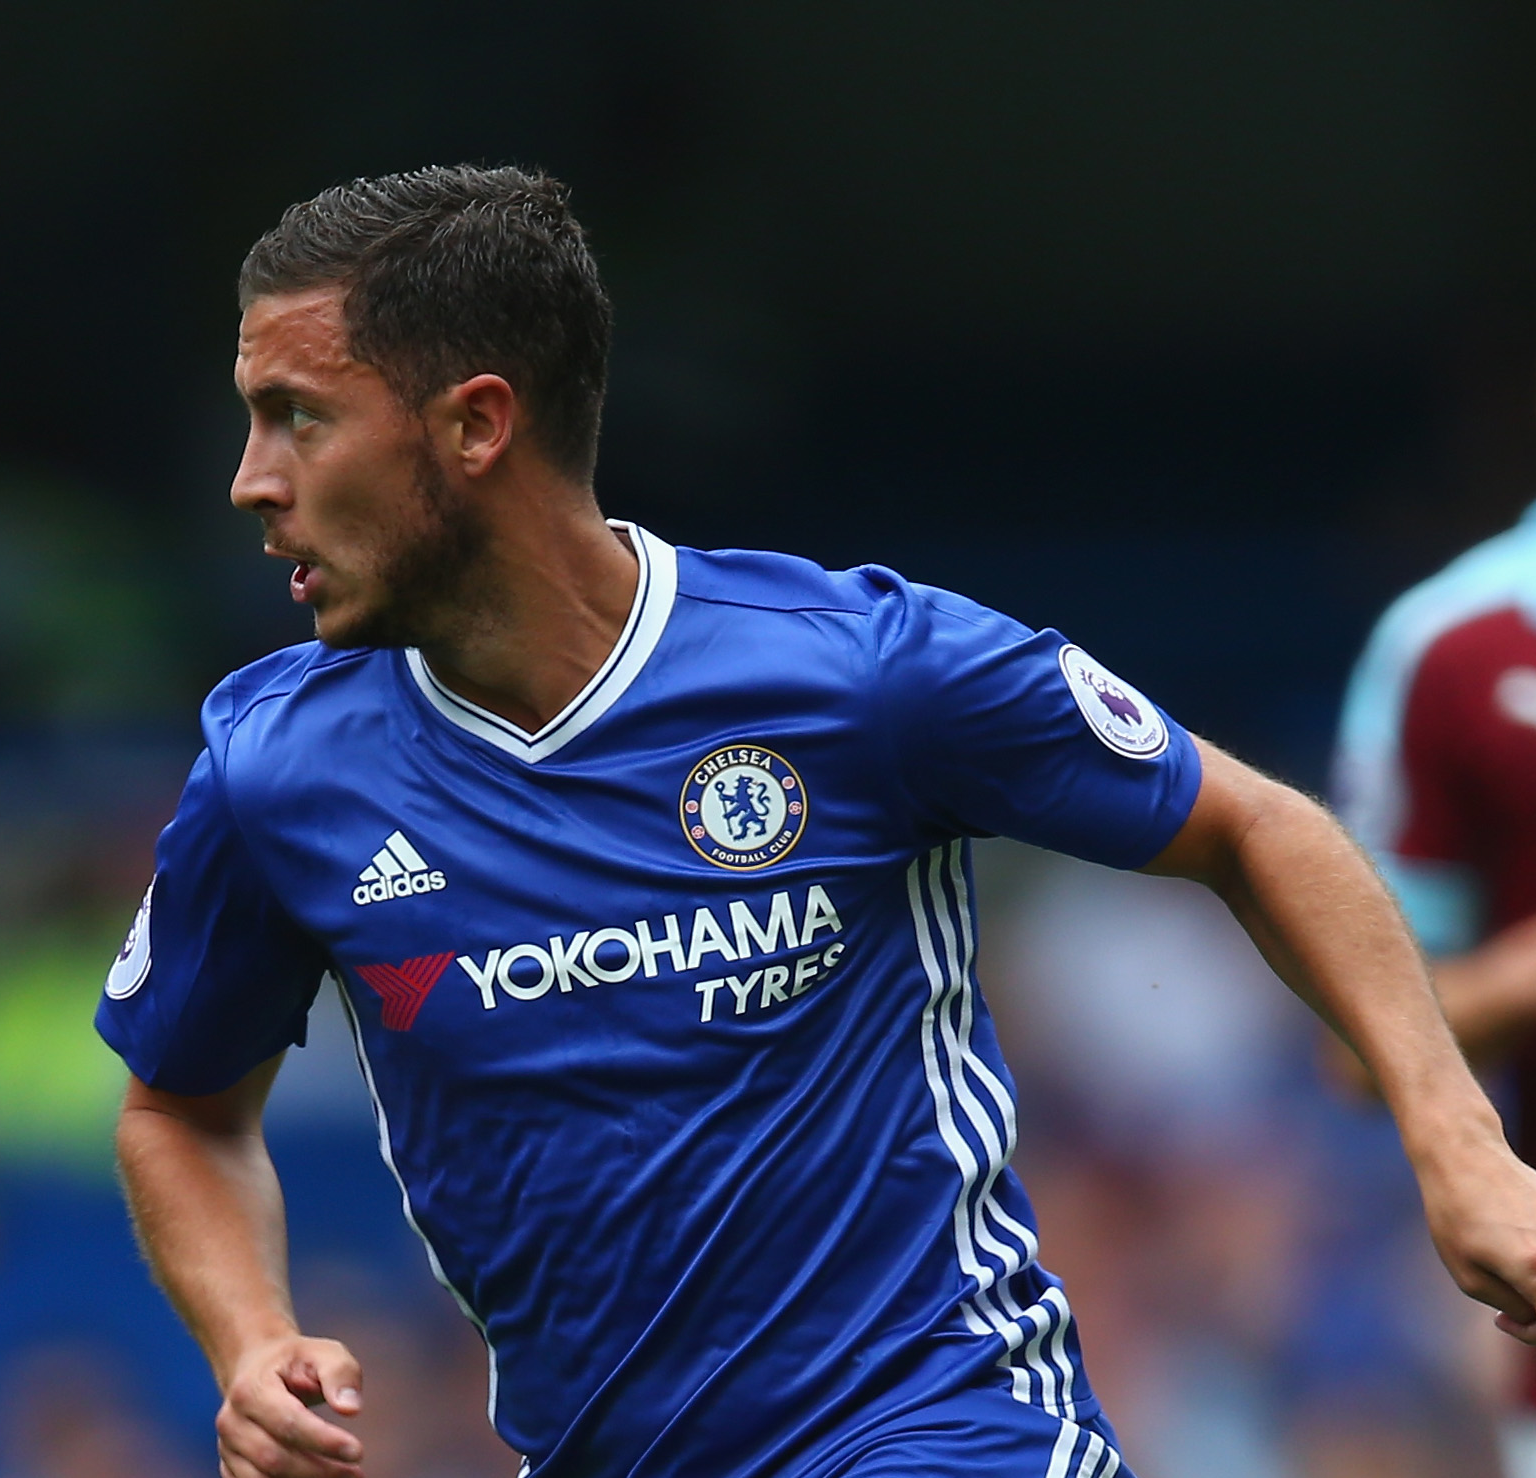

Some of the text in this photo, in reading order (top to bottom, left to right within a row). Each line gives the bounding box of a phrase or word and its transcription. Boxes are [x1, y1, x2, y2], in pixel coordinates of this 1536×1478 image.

[694, 749, 773, 786] CHELSEA
[711, 830, 794, 864] FOOTBALL CLUB
[352, 870, 448, 906] adidas
[456, 884, 844, 1010] YOKOHAMA
[694, 942, 846, 1023] TYRES
